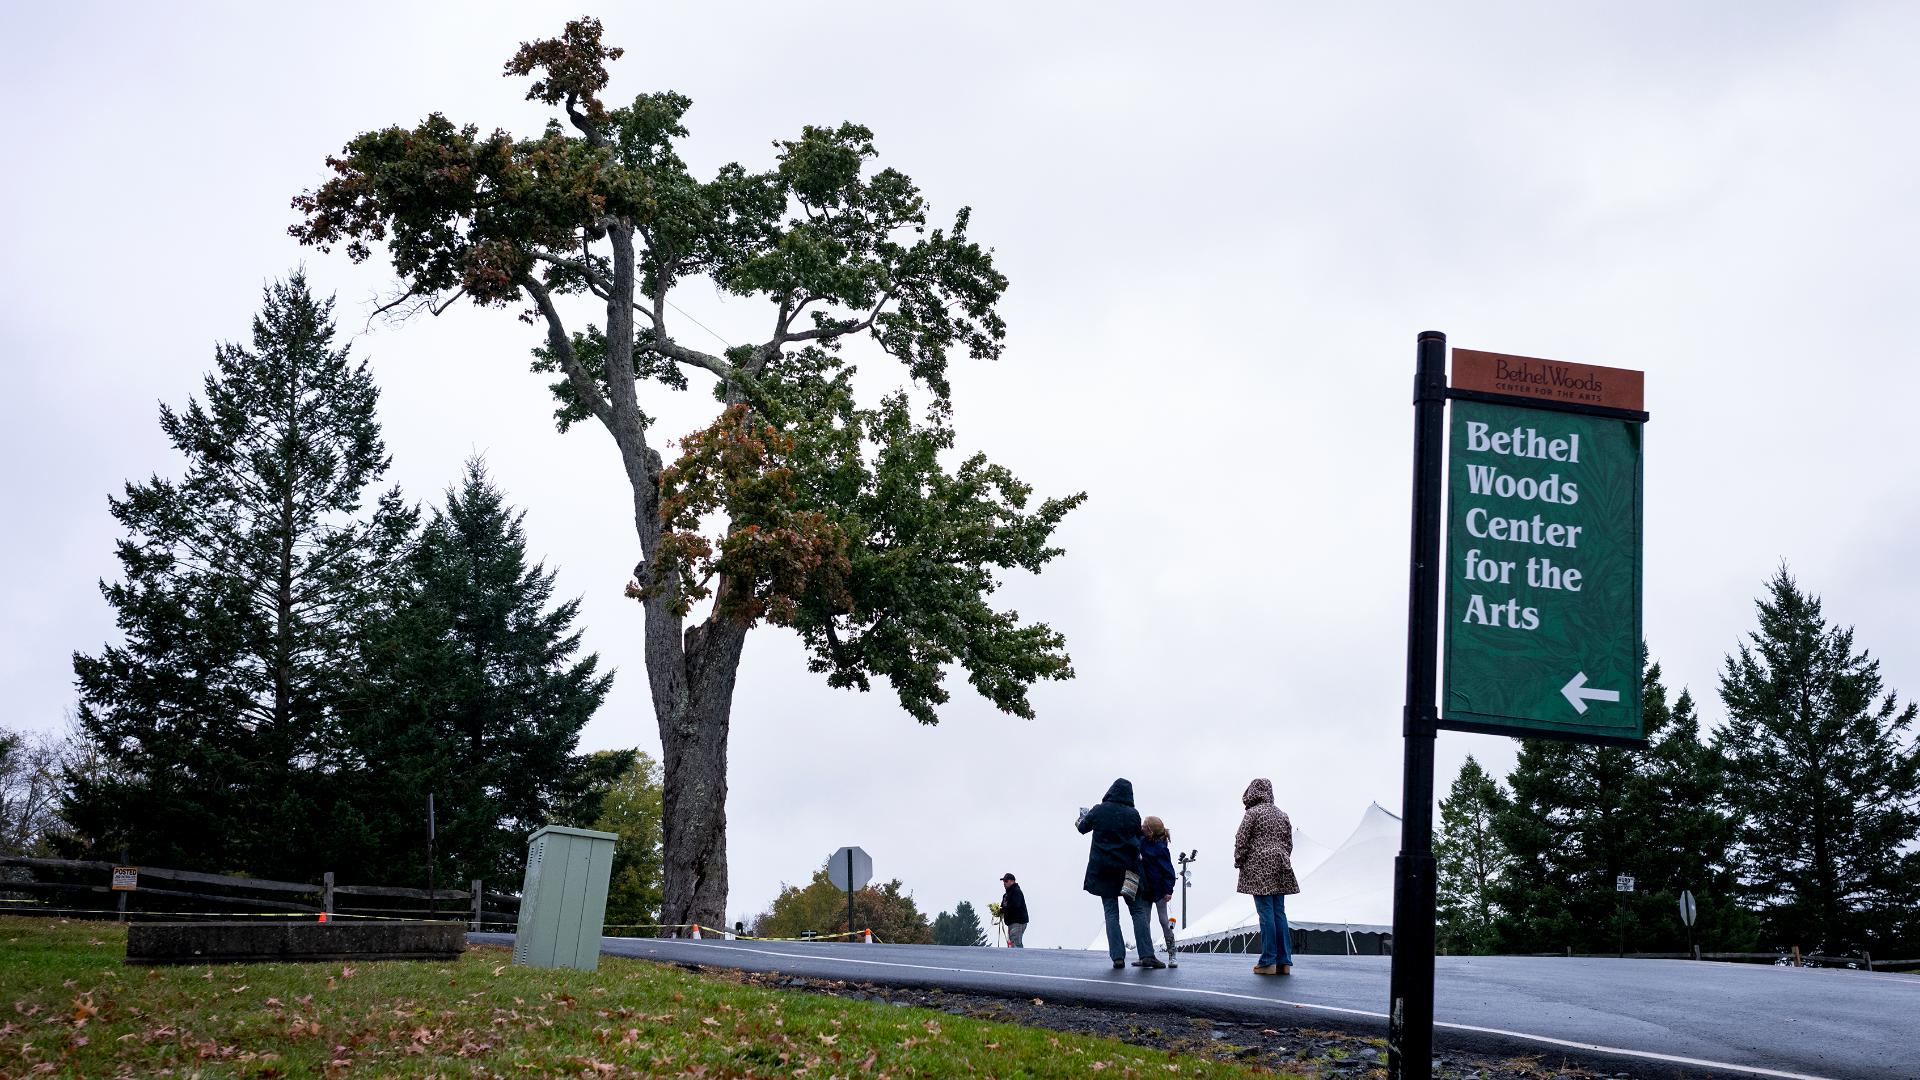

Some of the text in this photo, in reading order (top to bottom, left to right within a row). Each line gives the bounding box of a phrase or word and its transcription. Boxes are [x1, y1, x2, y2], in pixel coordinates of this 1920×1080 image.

[1496, 359, 1602, 392] Bethel Woods
[1496, 382, 1602, 402] CENTER FOR THE ARTS
[1466, 421, 1579, 463] Bethel
[1466, 464, 1579, 505] Woods
[1465, 507, 1582, 548] Center
[1464, 549, 1582, 591] for the
[1463, 594, 1540, 630] Arts
